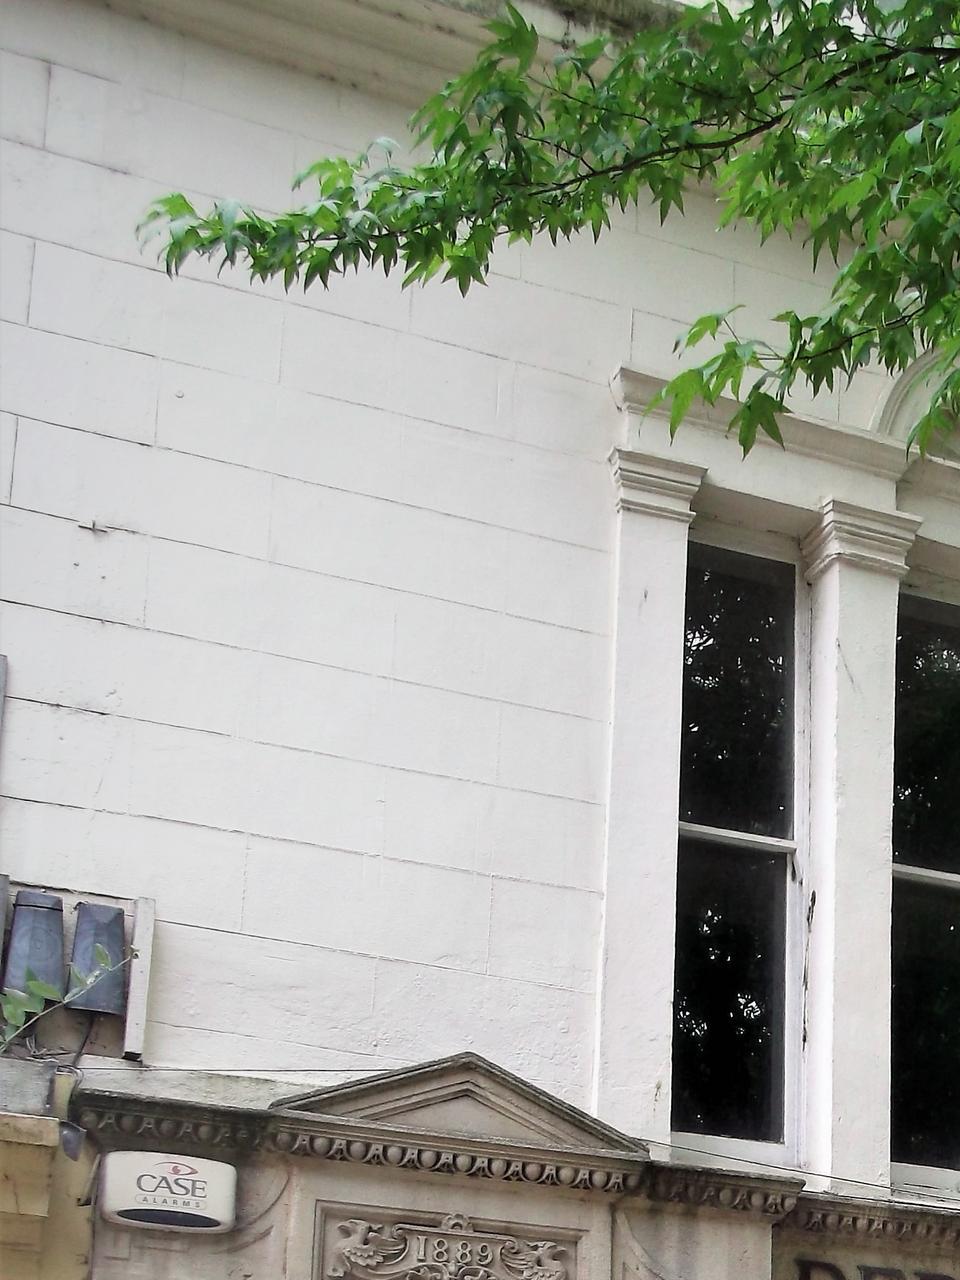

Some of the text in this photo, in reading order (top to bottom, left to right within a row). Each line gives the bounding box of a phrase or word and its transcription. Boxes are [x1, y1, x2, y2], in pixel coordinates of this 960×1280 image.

[137, 1174, 207, 1198] CASE
[142, 1196, 200, 1208] ALARMS
[417, 1235, 493, 1265] 1889
